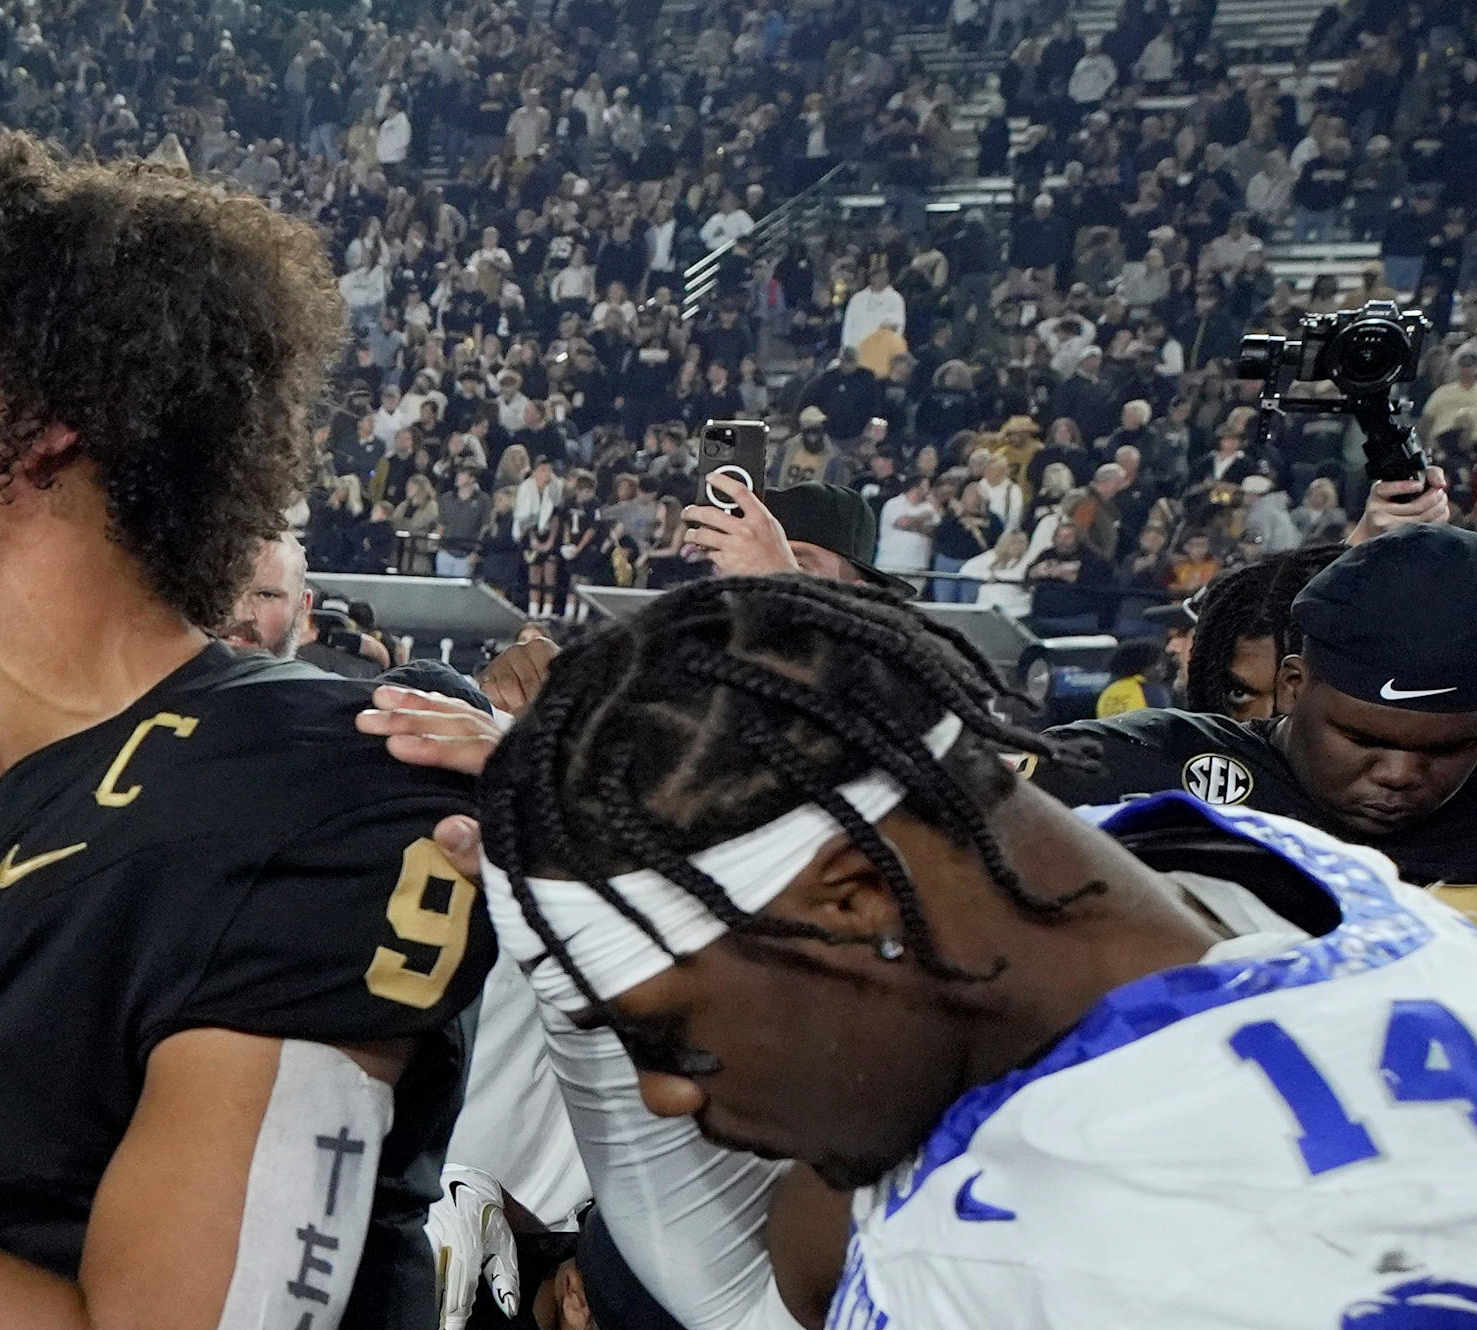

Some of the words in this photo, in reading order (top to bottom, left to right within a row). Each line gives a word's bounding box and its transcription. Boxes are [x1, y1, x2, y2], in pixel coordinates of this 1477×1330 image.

[95, 712, 200, 808] C
[1189, 758, 1249, 801] SEC
[365, 837, 478, 1010] 9
[1227, 998, 1477, 1177] 14
